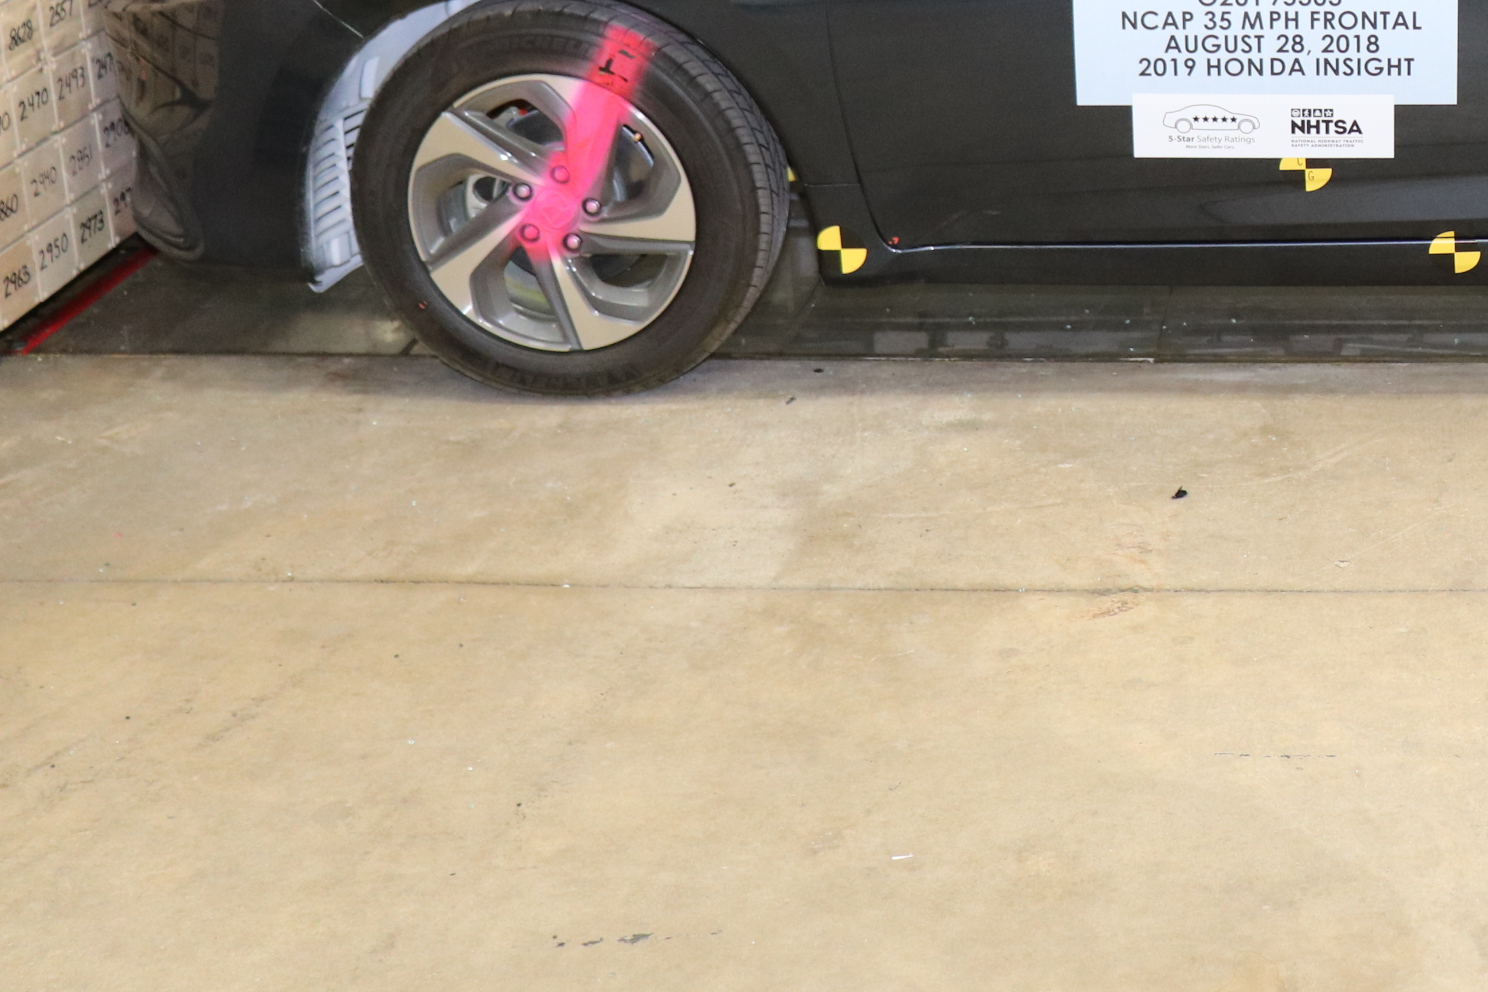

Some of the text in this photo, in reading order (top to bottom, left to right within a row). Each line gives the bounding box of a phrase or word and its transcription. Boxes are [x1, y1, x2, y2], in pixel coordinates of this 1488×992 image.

[1121, 10, 1422, 31] NCAP 35 MPH FRONTAL
[1164, 34, 1380, 56] AUGUST 28, 2018
[1138, 57, 1415, 77] 2019 HONDA INSIGHT
[18, 86, 50, 123] 2470
[56, 65, 87, 101] 2493
[1290, 119, 1363, 135] NHTSA
[1168, 135, 1256, 145] 5-Star Safety Ratings
[30, 165, 58, 198] 2940
[1308, 171, 1315, 181] G
[38, 231, 69, 272] 2950
[80, 209, 105, 245] 2973
